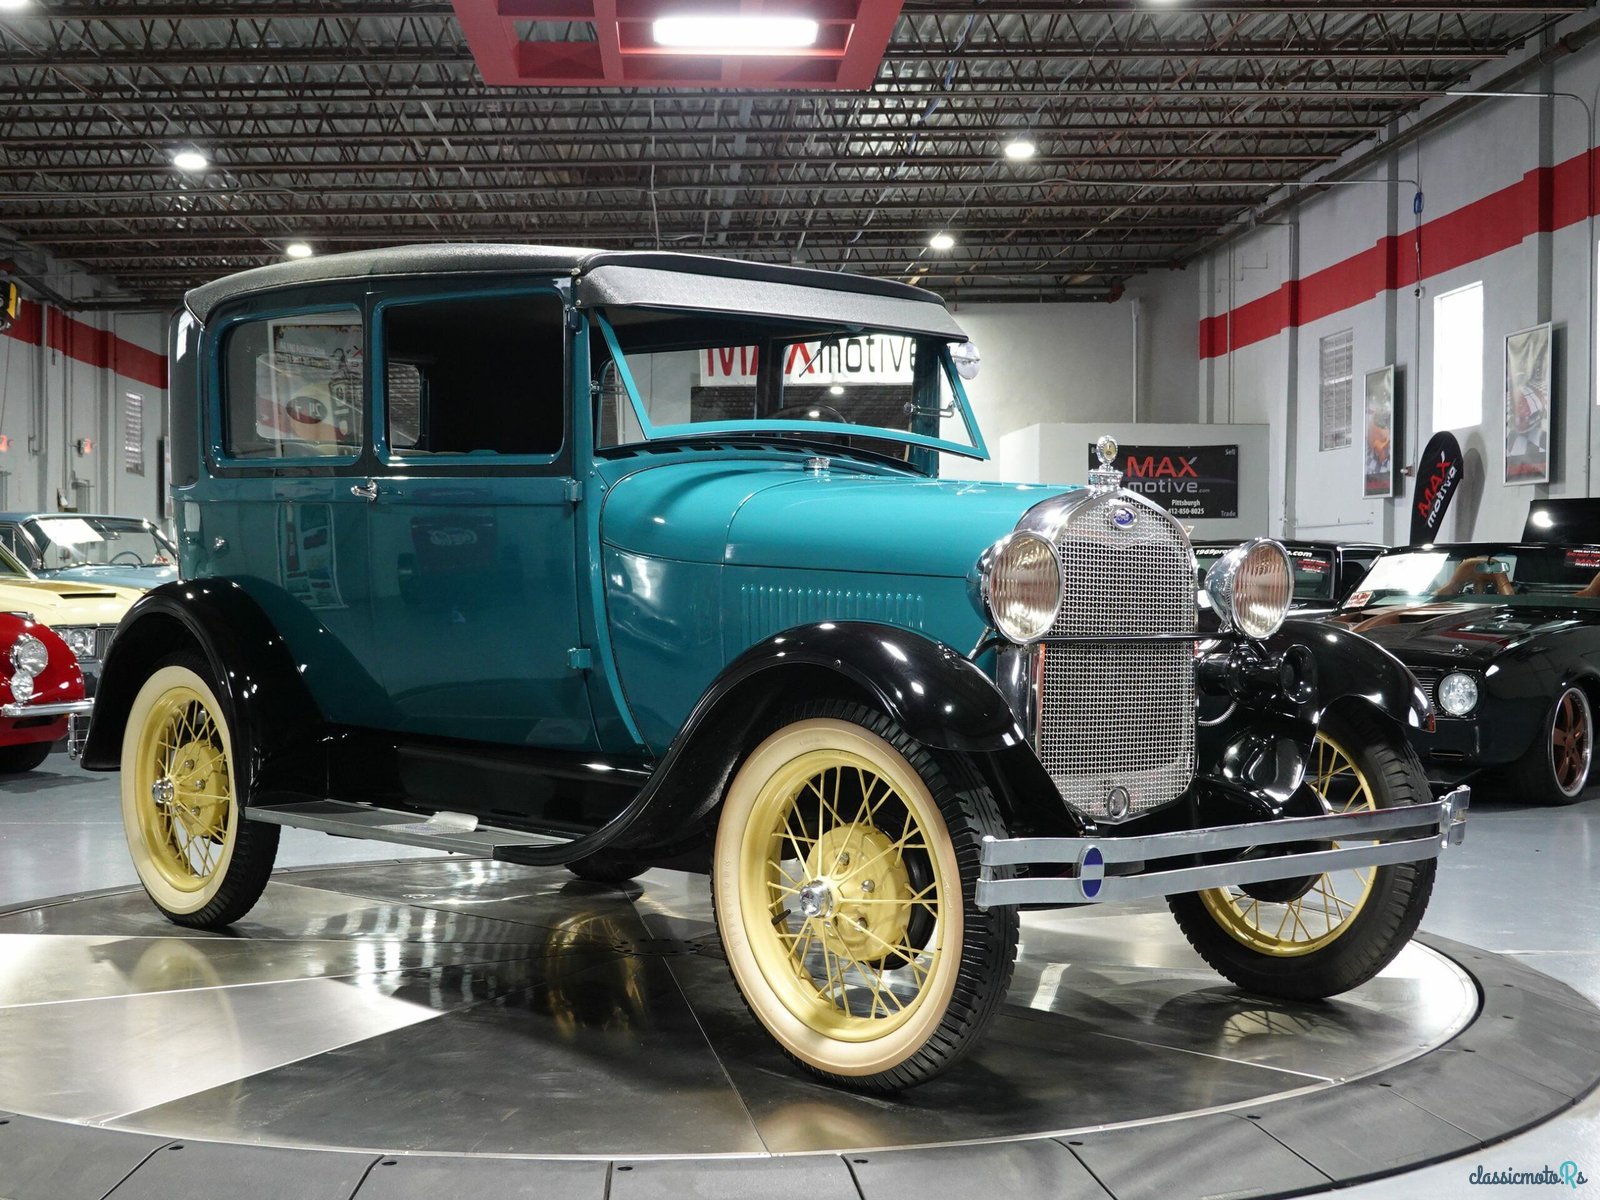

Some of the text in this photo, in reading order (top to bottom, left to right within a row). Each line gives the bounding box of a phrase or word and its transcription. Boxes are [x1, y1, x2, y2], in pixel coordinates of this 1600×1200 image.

[1127, 456, 1198, 477] MAX
[1418, 450, 1452, 518] MAX
[1171, 499, 1201, 507] Pittsburgh
[1427, 465, 1458, 528] motive
